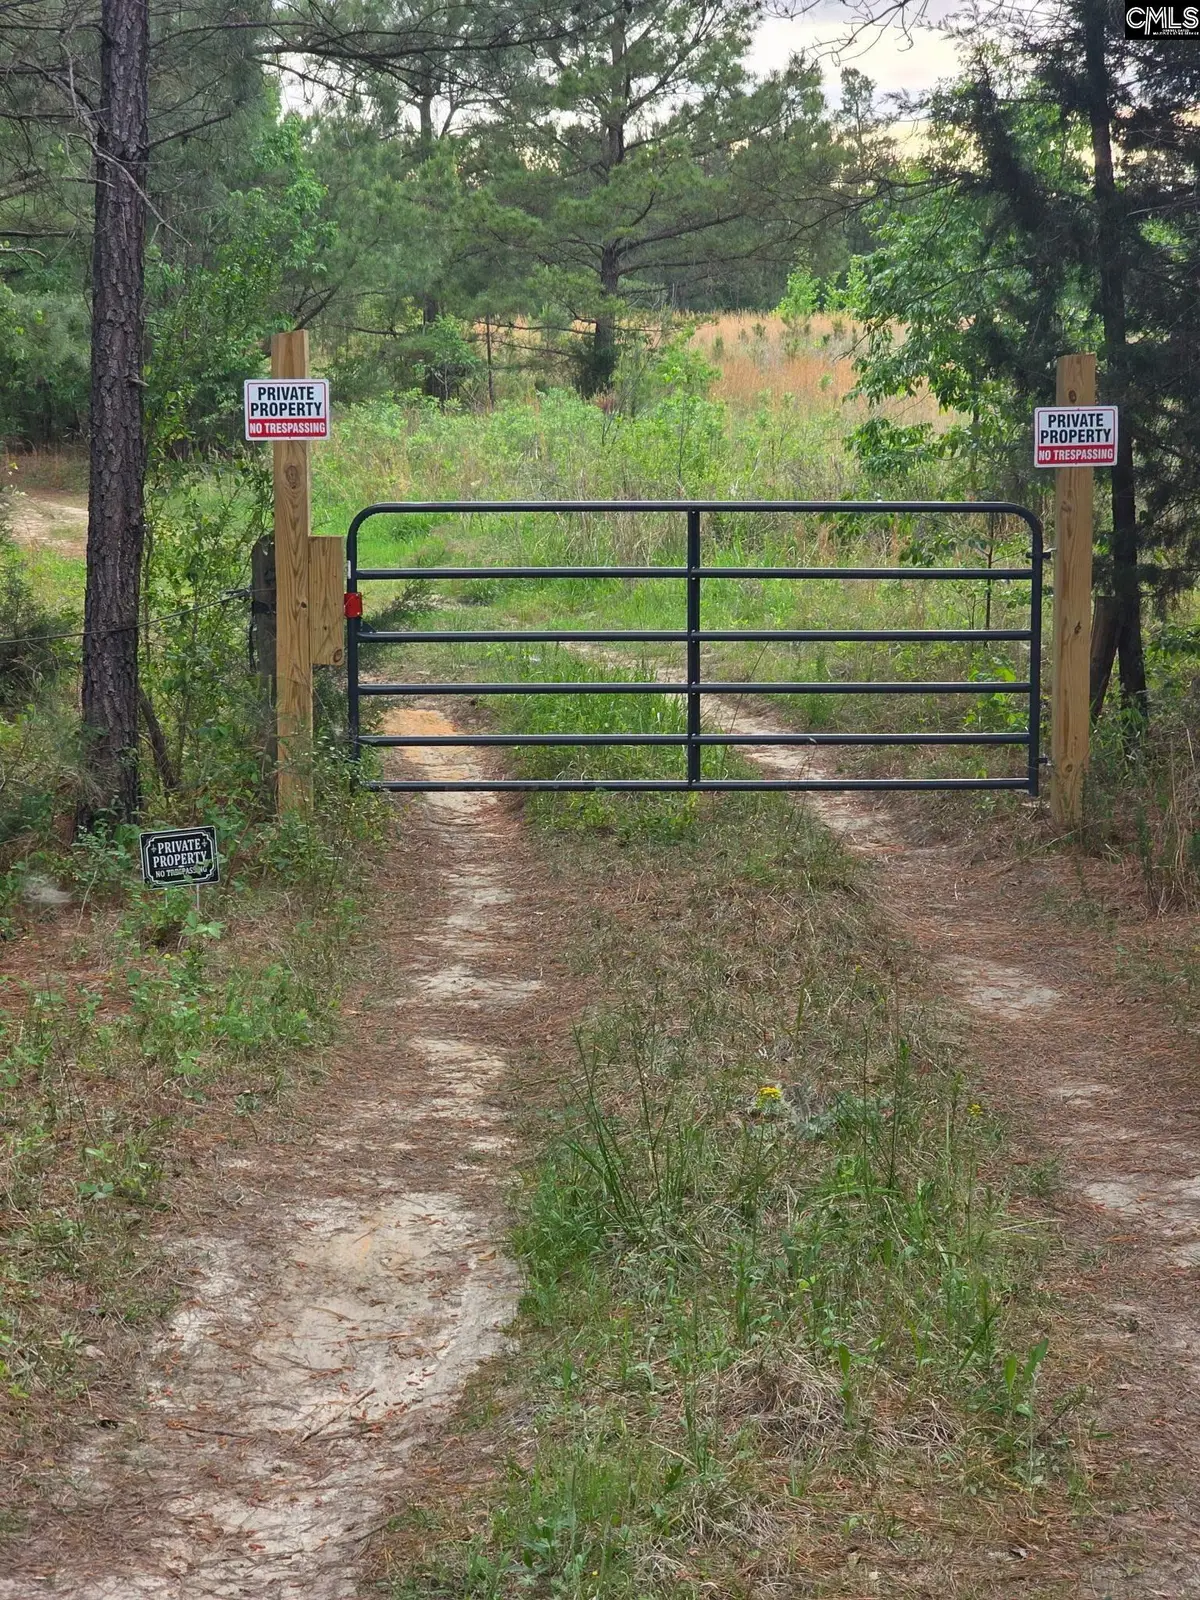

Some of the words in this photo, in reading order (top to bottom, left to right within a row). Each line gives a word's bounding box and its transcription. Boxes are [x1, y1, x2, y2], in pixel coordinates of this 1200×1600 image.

[258, 386, 314, 401] PRIVATE
[251, 402, 322, 416] PROPERTY
[1048, 413, 1103, 428] PRIVATE
[250, 423, 262, 434] NO
[264, 423, 325, 434] TRESPASSING
[1041, 429, 1111, 443] PROPERTY
[1038, 450, 1051, 461] NO
[1053, 449, 1113, 461] TRESPASSING
[157, 838, 201, 854] PRIVATE
[153, 850, 207, 868] PROPERTY
[155, 870, 165, 878] NO
